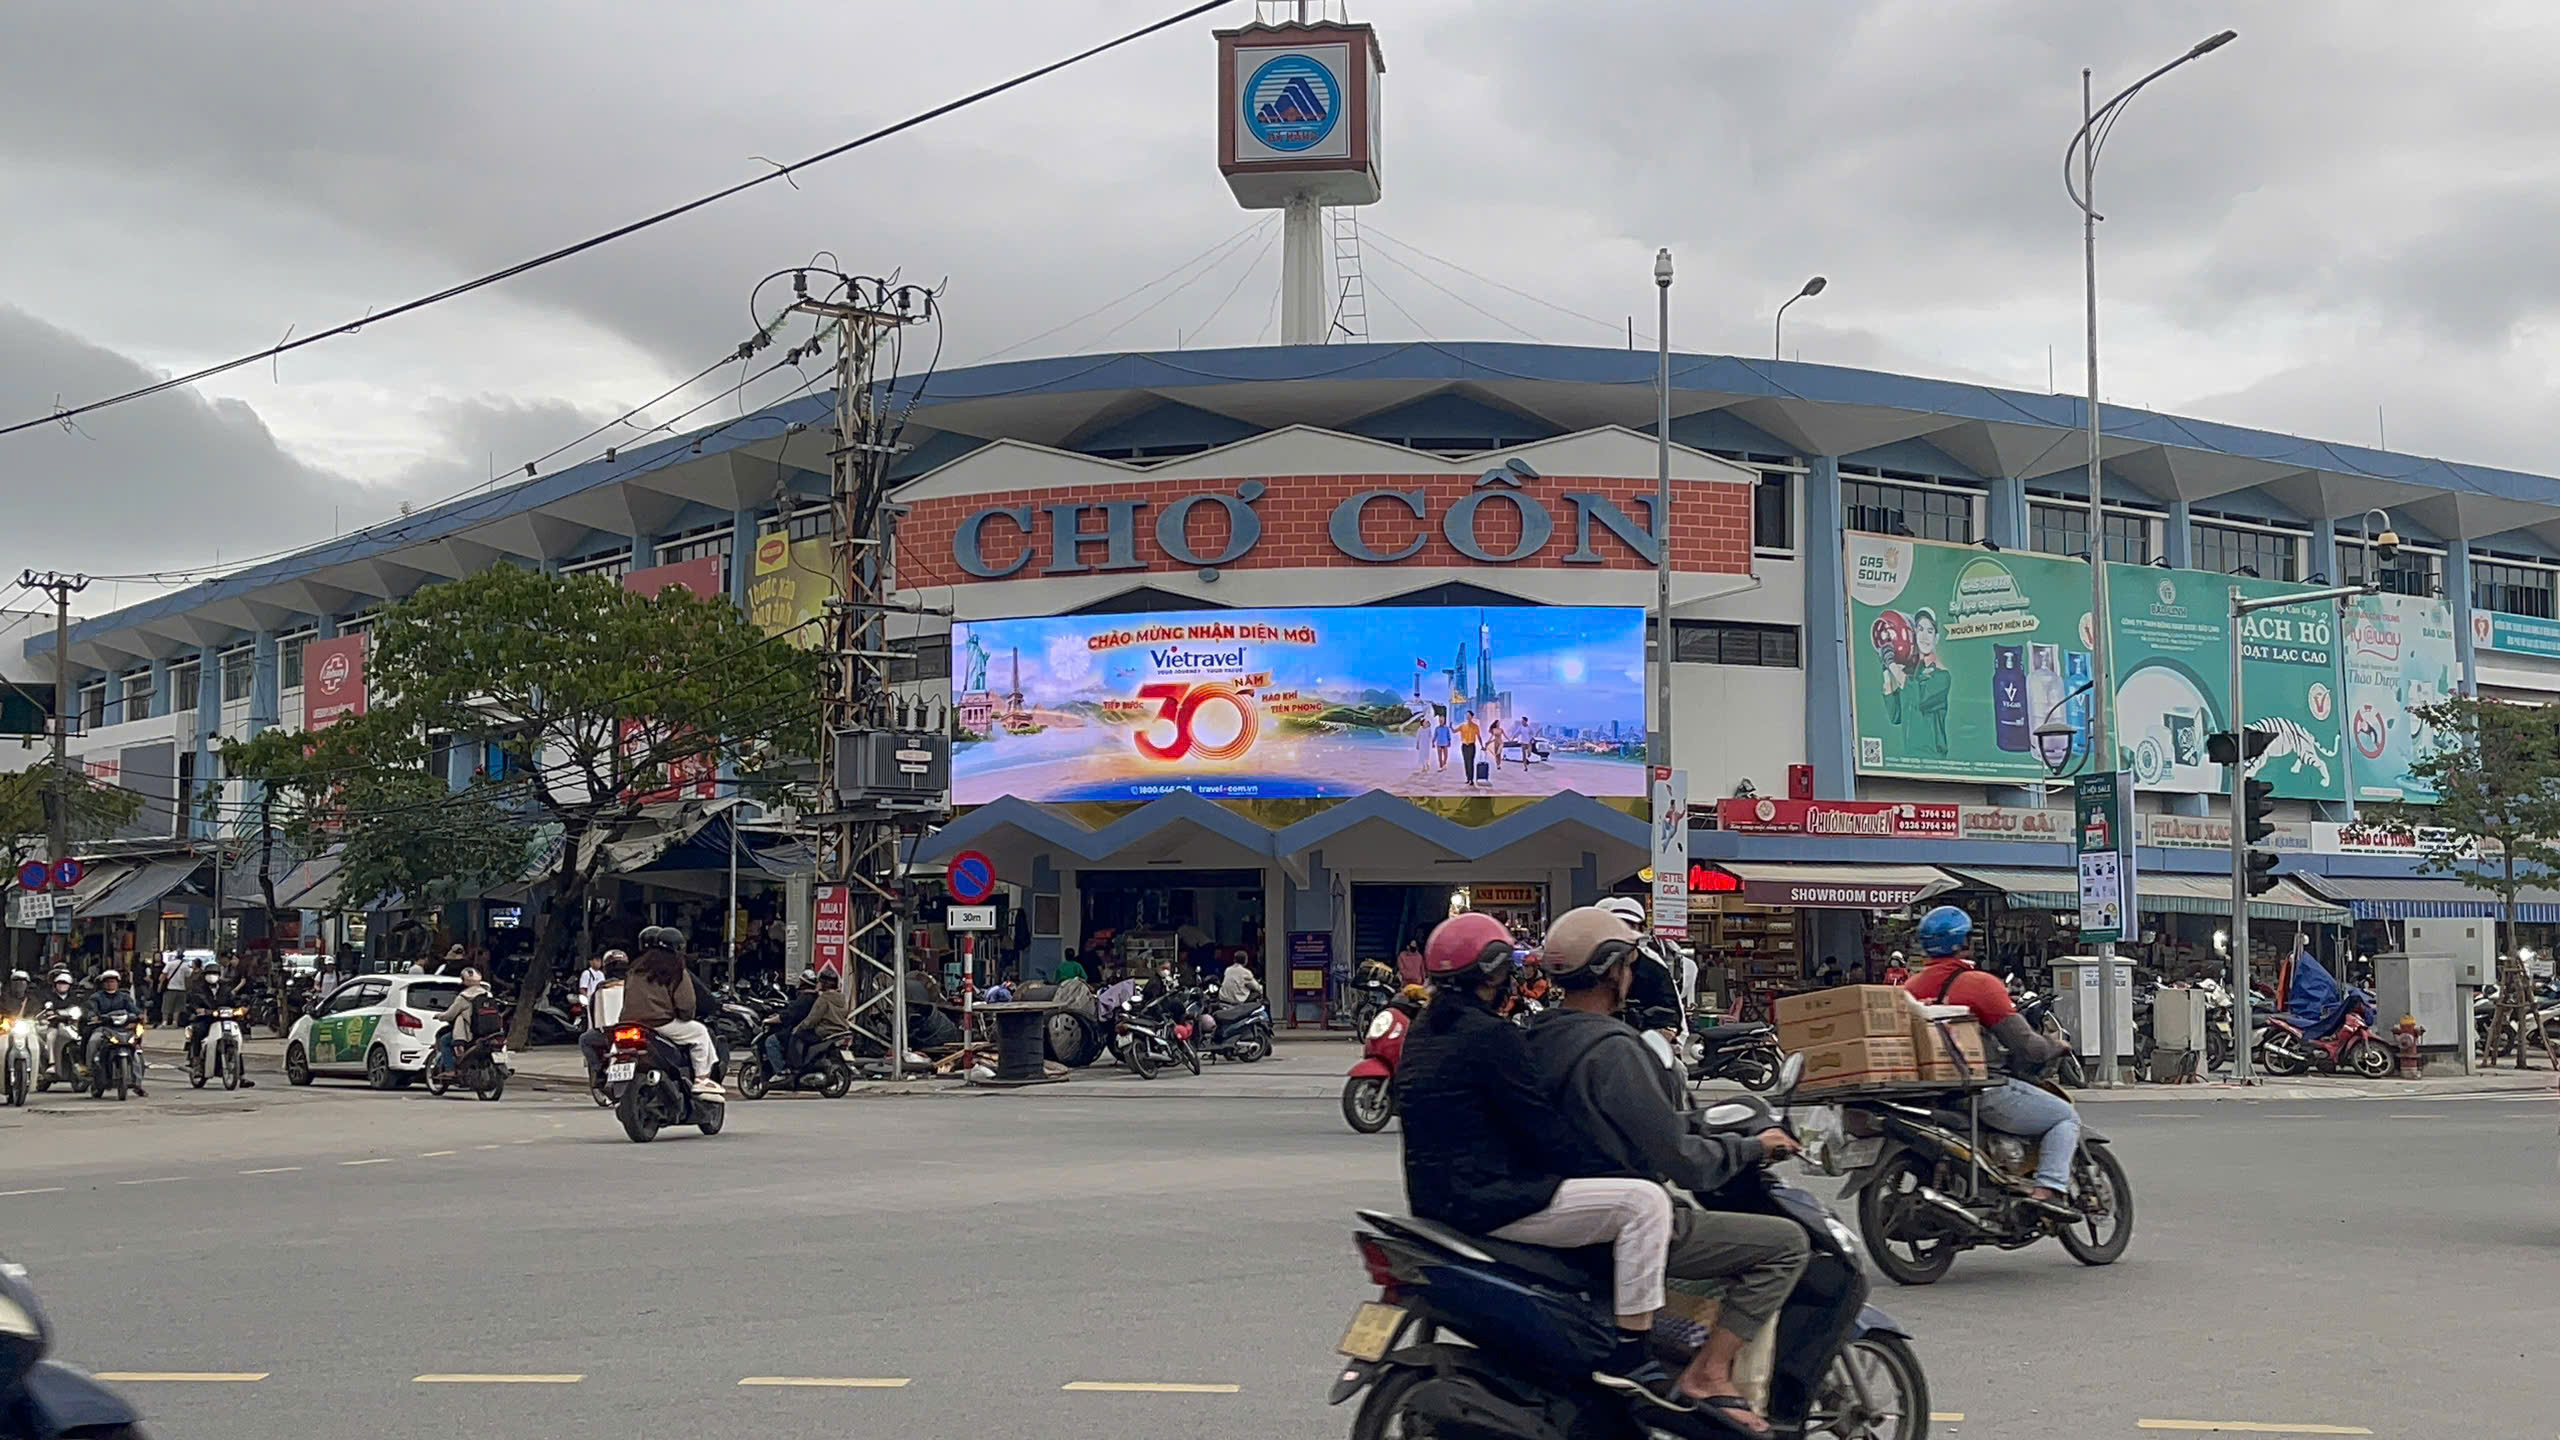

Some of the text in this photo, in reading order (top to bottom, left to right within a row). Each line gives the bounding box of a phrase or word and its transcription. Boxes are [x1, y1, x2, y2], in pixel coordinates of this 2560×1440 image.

[953, 457, 1673, 580] CHỢ CỒN
[1859, 555, 1884, 568] GAS
[1858, 569, 1897, 583] SOUTH
[1951, 624, 1974, 635] NGƯỜI
[1975, 624, 1988, 634] NỘI
[1990, 622, 2003, 632] TRỢ
[2241, 616, 2292, 642] ẠCH
[2298, 611, 2330, 645] HỔ
[1088, 622, 1316, 650] CHÀO MỪNG NHẬN DIỆN MỚI
[1151, 646, 1244, 668] Vietravel
[2272, 648, 2299, 662] LẠC
[2302, 650, 2327, 664] CAO
[1292, 702, 1322, 712] PHONG
[1134, 676, 1264, 761] 30 NĂM
[1899, 821, 1919, 830] 0236
[1656, 872, 1685, 884] VIETTEL
[1663, 884, 1680, 895] GIGA
[1790, 887, 1866, 903] SHOWROOM
[820, 903, 839, 914] MUA
[962, 913, 982, 922] 30m
